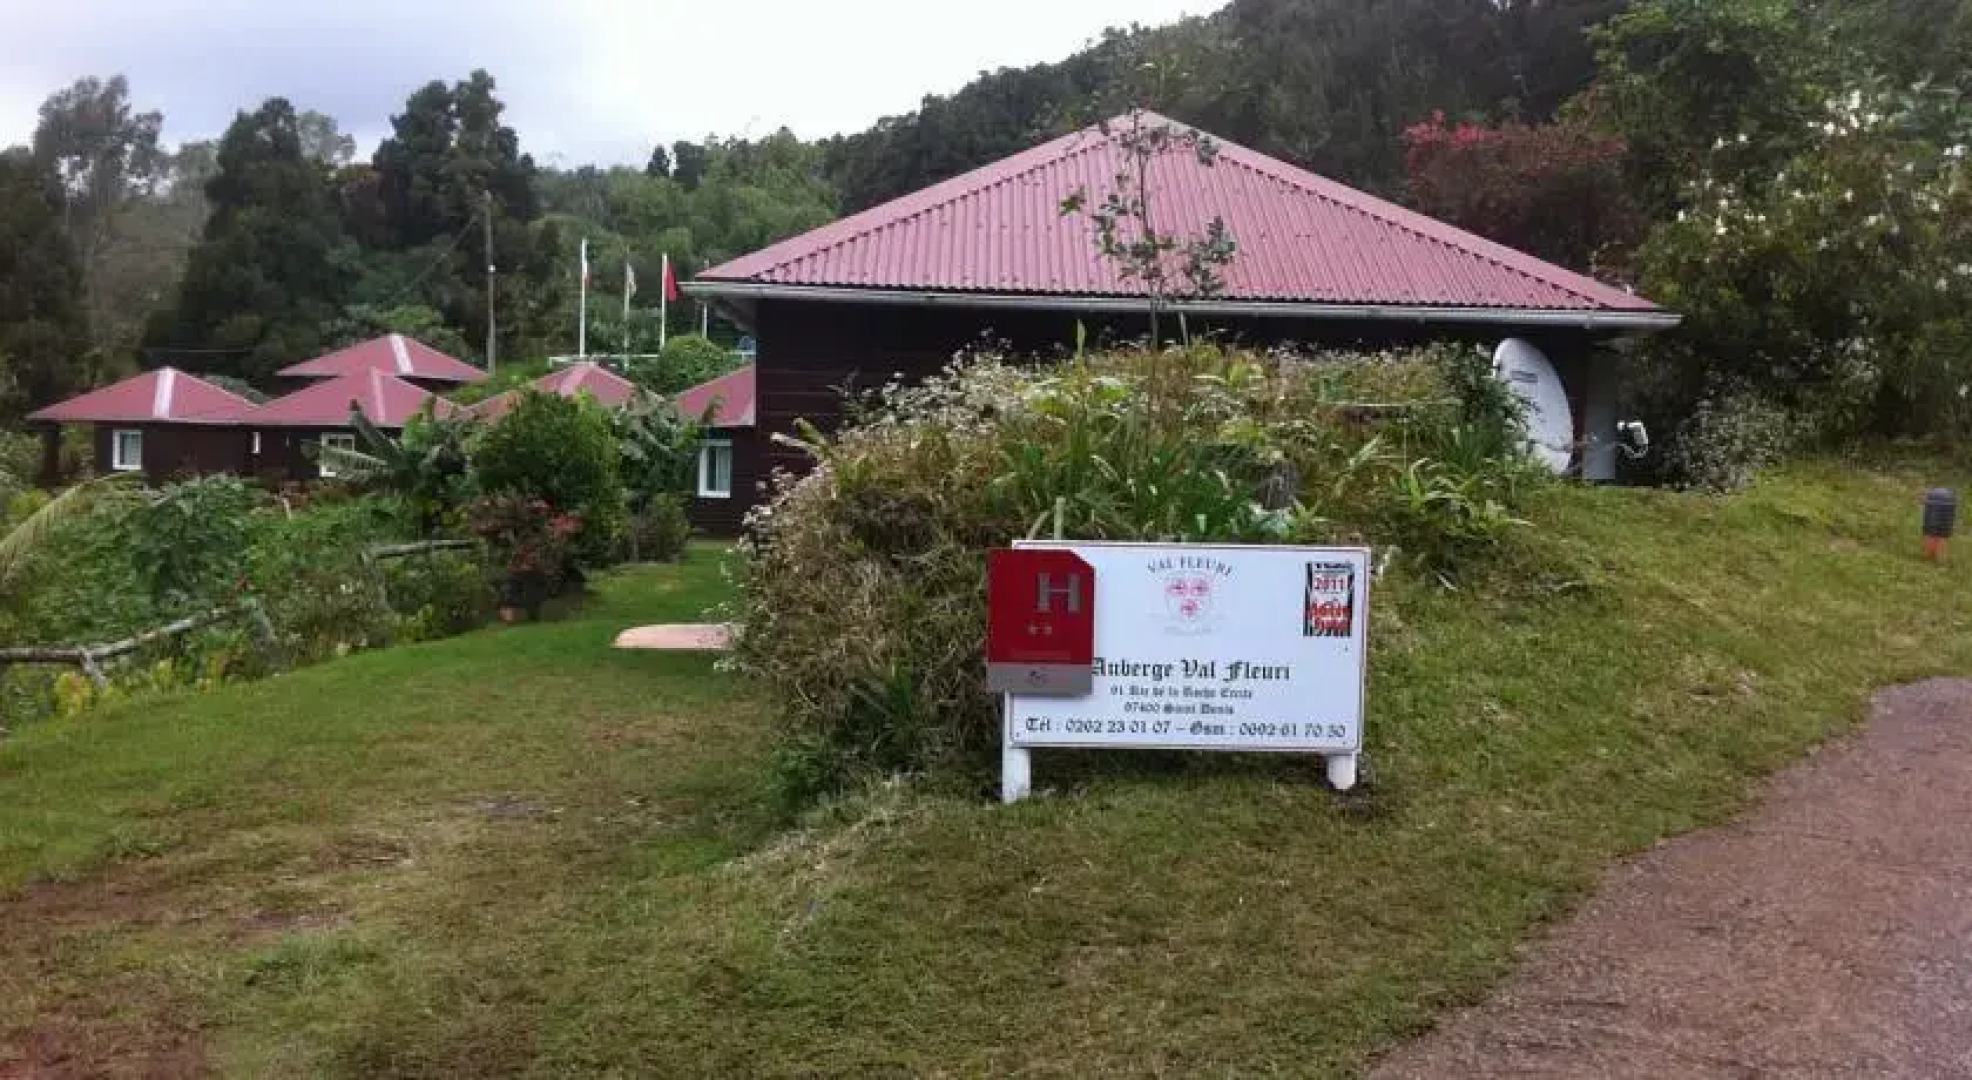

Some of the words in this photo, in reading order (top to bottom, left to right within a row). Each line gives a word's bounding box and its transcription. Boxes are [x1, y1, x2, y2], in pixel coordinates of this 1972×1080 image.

[1035, 571, 1081, 613] H
[1091, 657, 1174, 681] Auberge
[1180, 658, 1216, 680] Val
[1222, 659, 1291, 683] Fleuri
